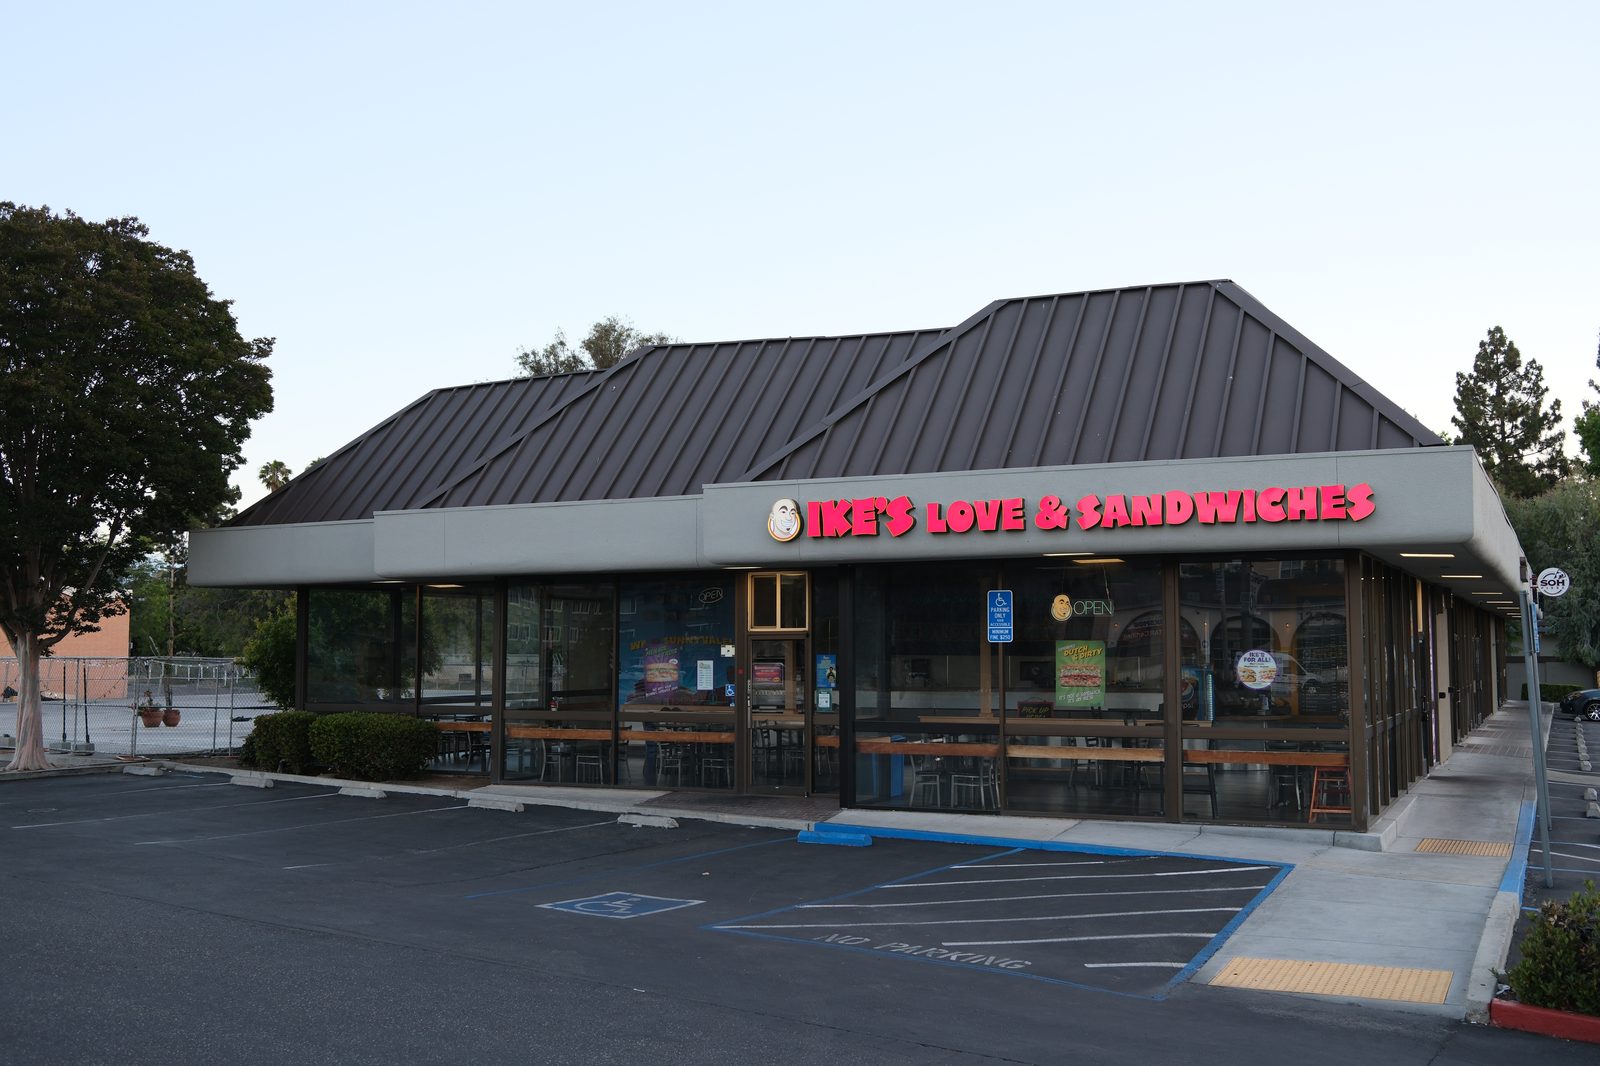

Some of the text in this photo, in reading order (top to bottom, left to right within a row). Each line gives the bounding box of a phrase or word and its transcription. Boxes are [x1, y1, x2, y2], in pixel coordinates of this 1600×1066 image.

[807, 483, 1376, 537] IKE'S LOVE & SANDWICHES
[698, 590, 723, 601] OPEN
[1073, 600, 1113, 616] OPEN
[1063, 645, 1089, 656] DUTCH
[1079, 648, 1103, 659] DIRTY
[813, 933, 1032, 969] NO PARKING
